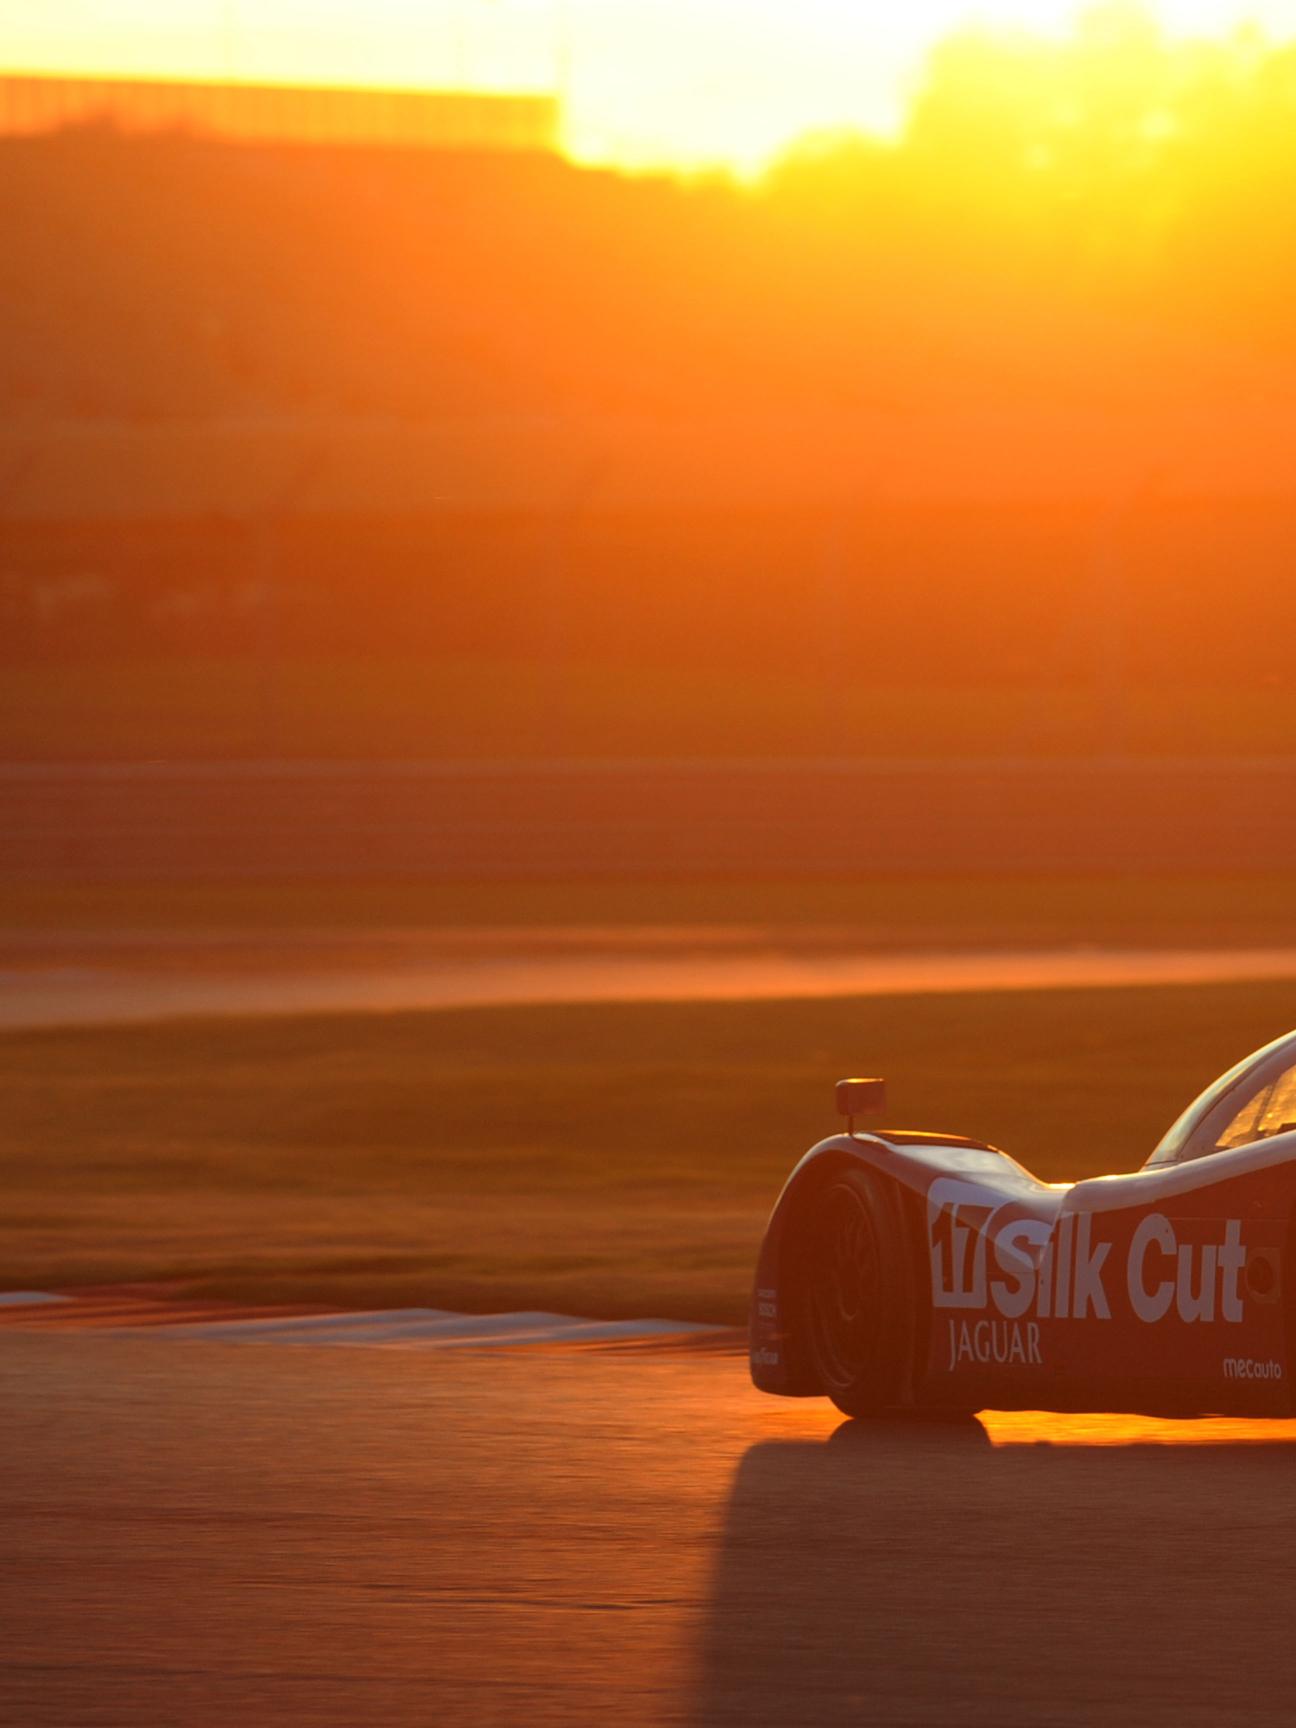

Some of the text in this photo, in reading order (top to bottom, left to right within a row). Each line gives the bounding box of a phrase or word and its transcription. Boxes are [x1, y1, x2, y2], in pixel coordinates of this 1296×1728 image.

[931, 1201, 997, 1294] 17
[991, 1209, 1247, 1323] Silk Cut
[949, 1319, 1043, 1371] JAGUAR
[1223, 1358, 1282, 1379] mecauto
